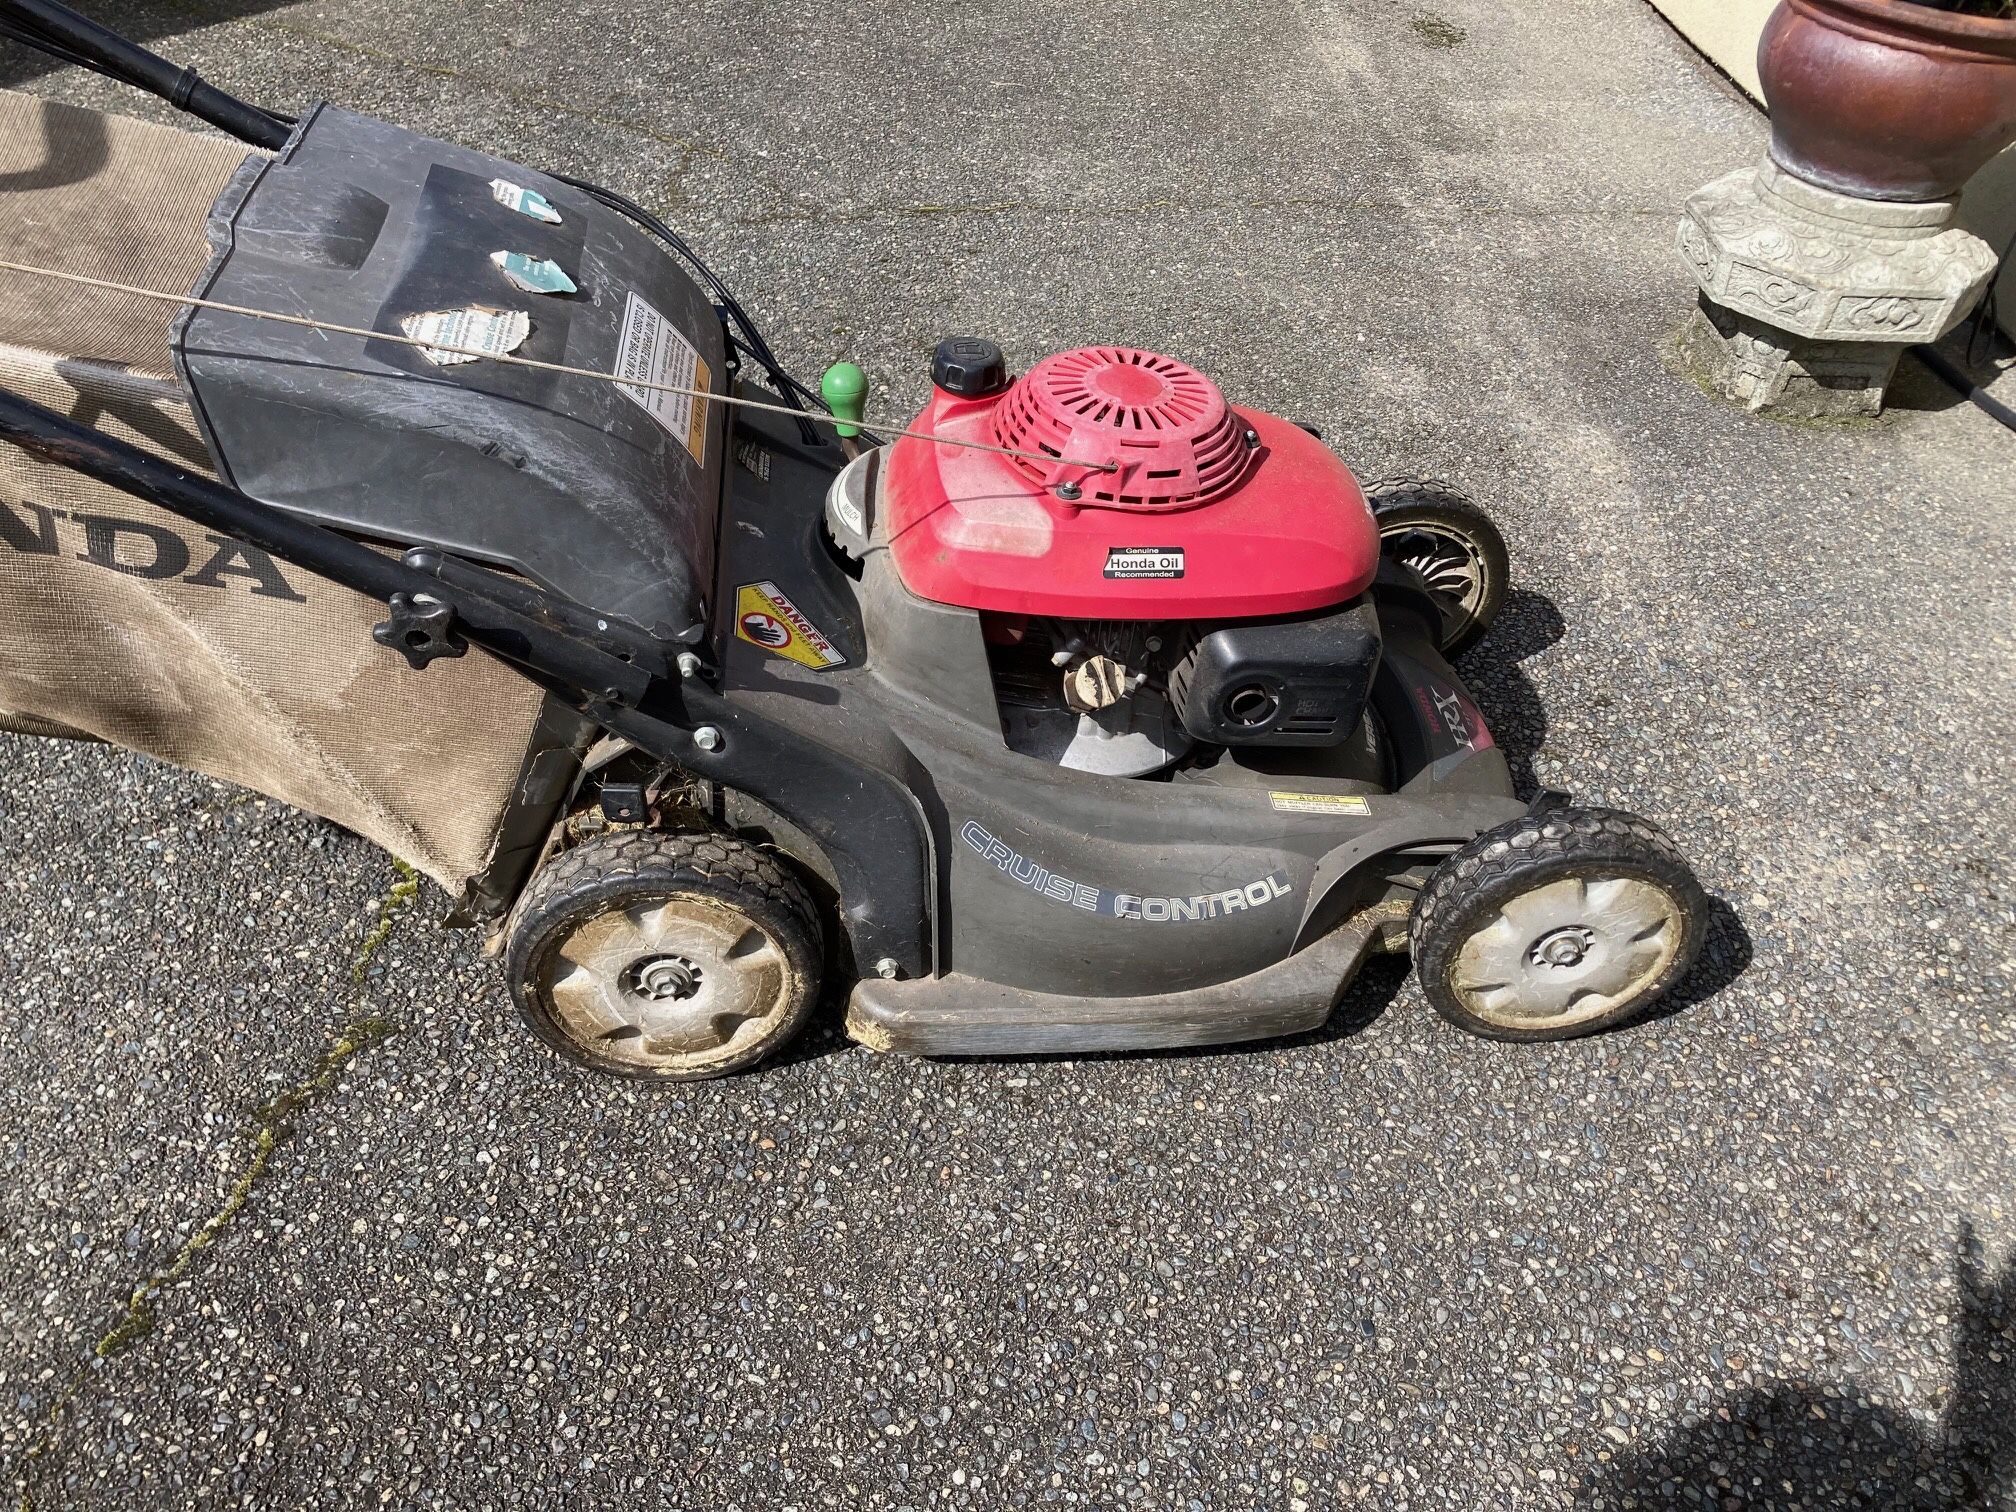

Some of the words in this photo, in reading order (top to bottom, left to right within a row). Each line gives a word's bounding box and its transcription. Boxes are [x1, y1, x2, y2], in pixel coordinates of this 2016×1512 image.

[633, 309, 644, 334] CLOSED
[646, 319, 655, 335] NOT
[629, 340, 639, 357] BAG
[642, 331, 653, 359] OPERATE
[639, 355, 650, 380] UNLESS
[842, 503, 860, 521] MULCH
[1110, 558, 1155, 569] Honda
[1160, 557, 1178, 569] Oil
[752, 587, 769, 606] KEEP
[767, 602, 788, 622] HANDS
[771, 595, 830, 651] DANGER
[961, 820, 1100, 911] CRUISE
[1114, 874, 1292, 921] CONTROL
